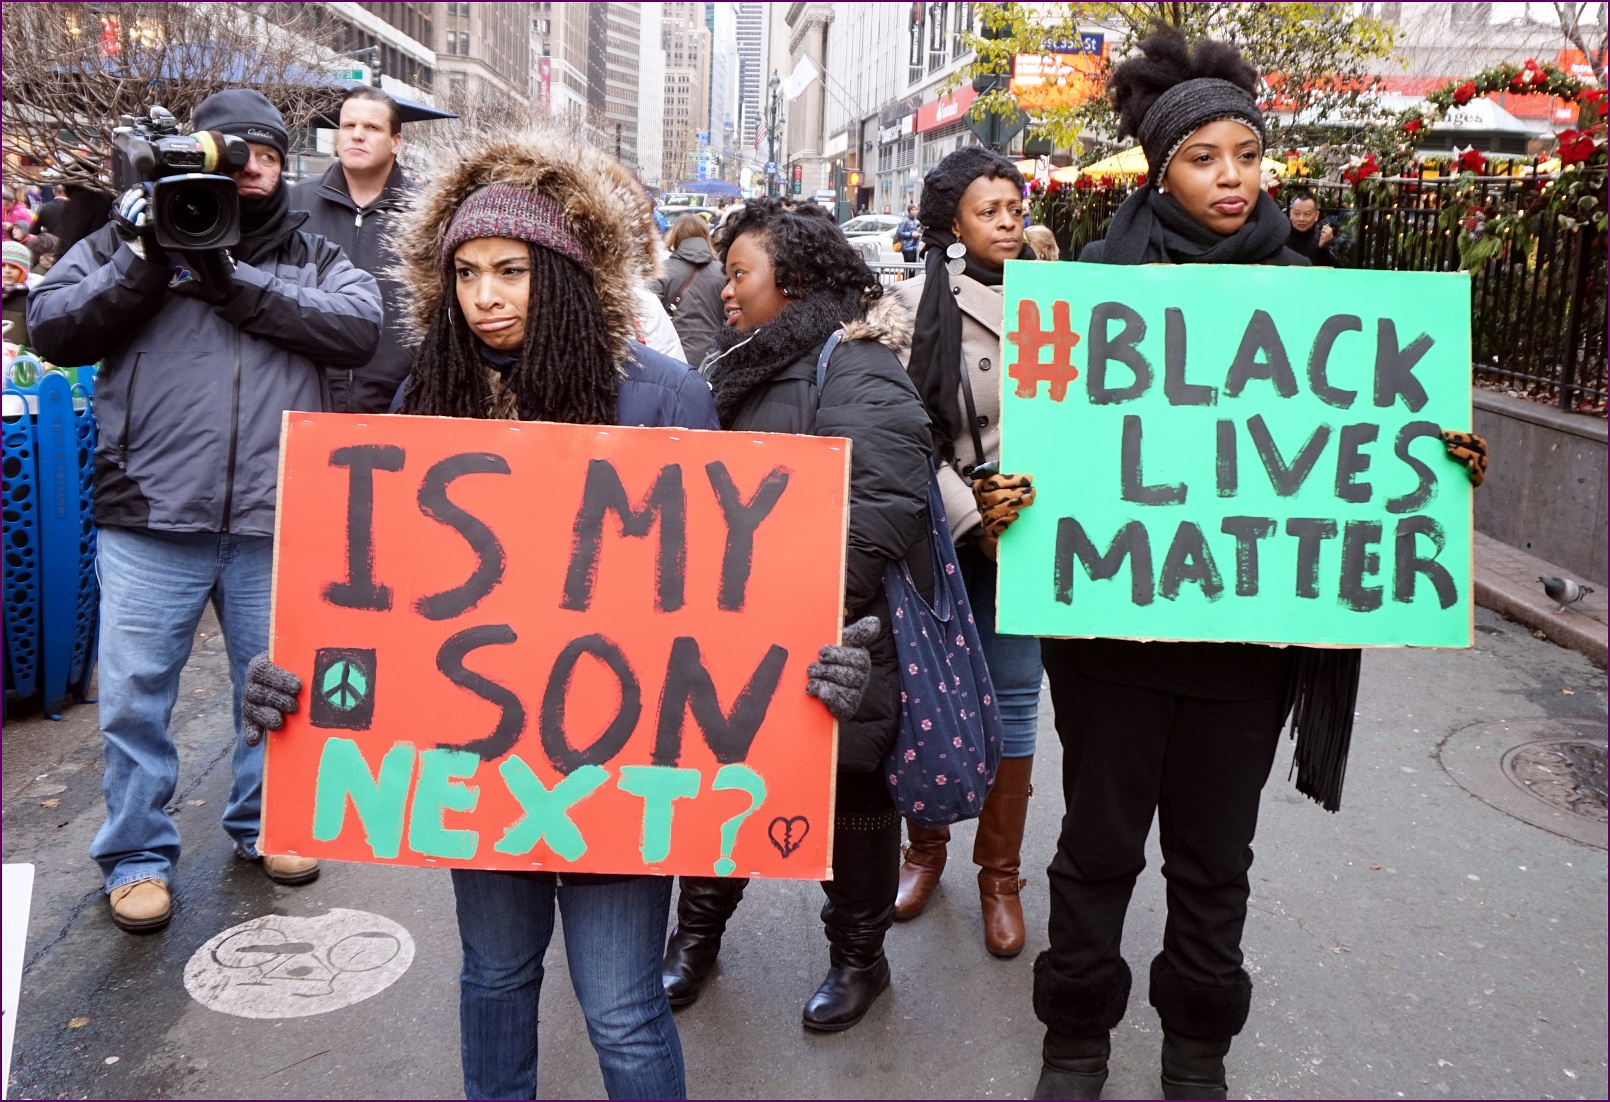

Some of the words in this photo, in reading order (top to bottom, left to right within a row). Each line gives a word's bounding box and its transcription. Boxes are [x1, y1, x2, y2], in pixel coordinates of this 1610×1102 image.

[1084, 37, 1097, 51] St
[1006, 299, 1435, 413] #BLACK
[1120, 413, 1444, 514] LIVES
[320, 444, 512, 620] IS
[558, 458, 794, 613] MY
[1054, 515, 1458, 612] MATTER
[434, 624, 789, 776] SON
[312, 737, 768, 877] NEXT?
